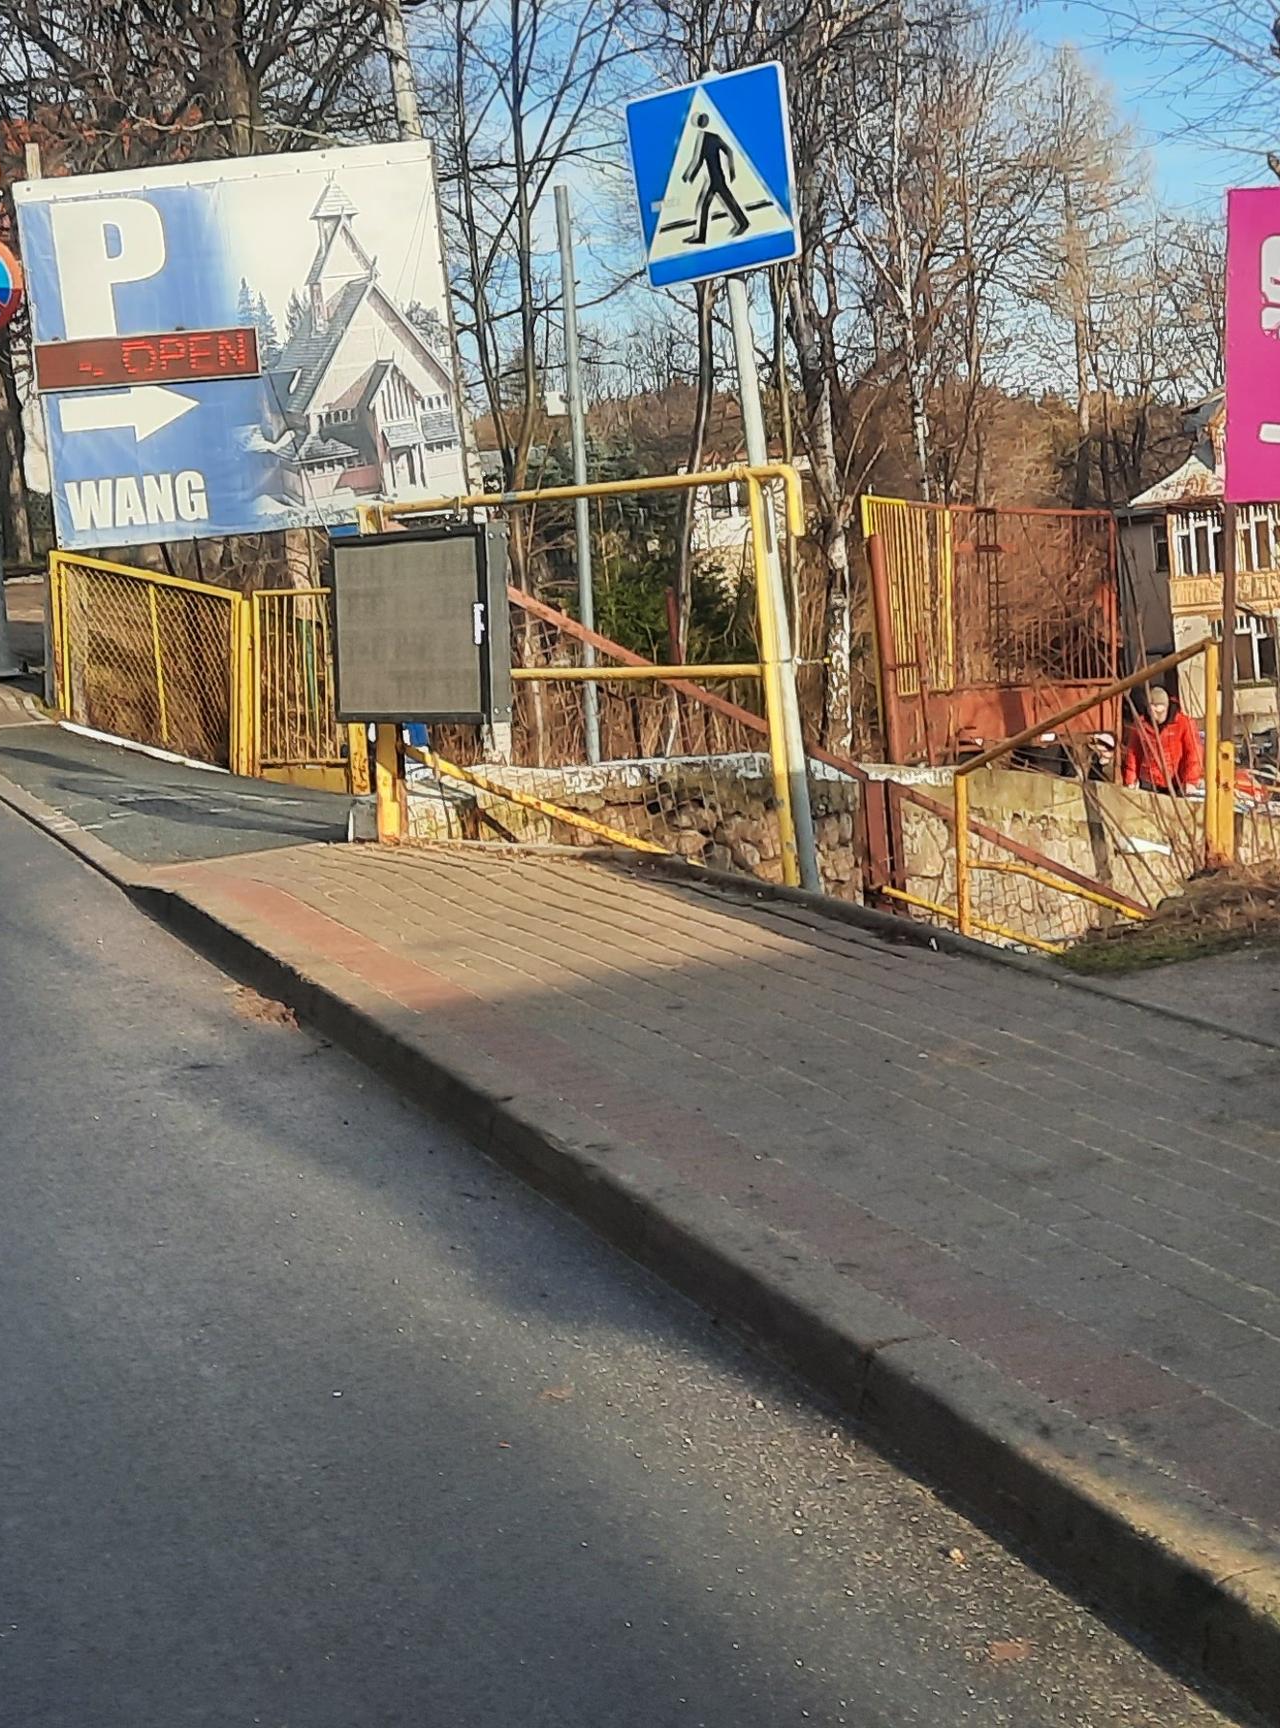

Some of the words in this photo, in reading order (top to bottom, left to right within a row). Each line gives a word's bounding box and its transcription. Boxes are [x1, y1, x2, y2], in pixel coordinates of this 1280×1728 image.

[49, 198, 167, 340] P
[120, 332, 247, 374] OPEN
[64, 470, 209, 532] WANG
